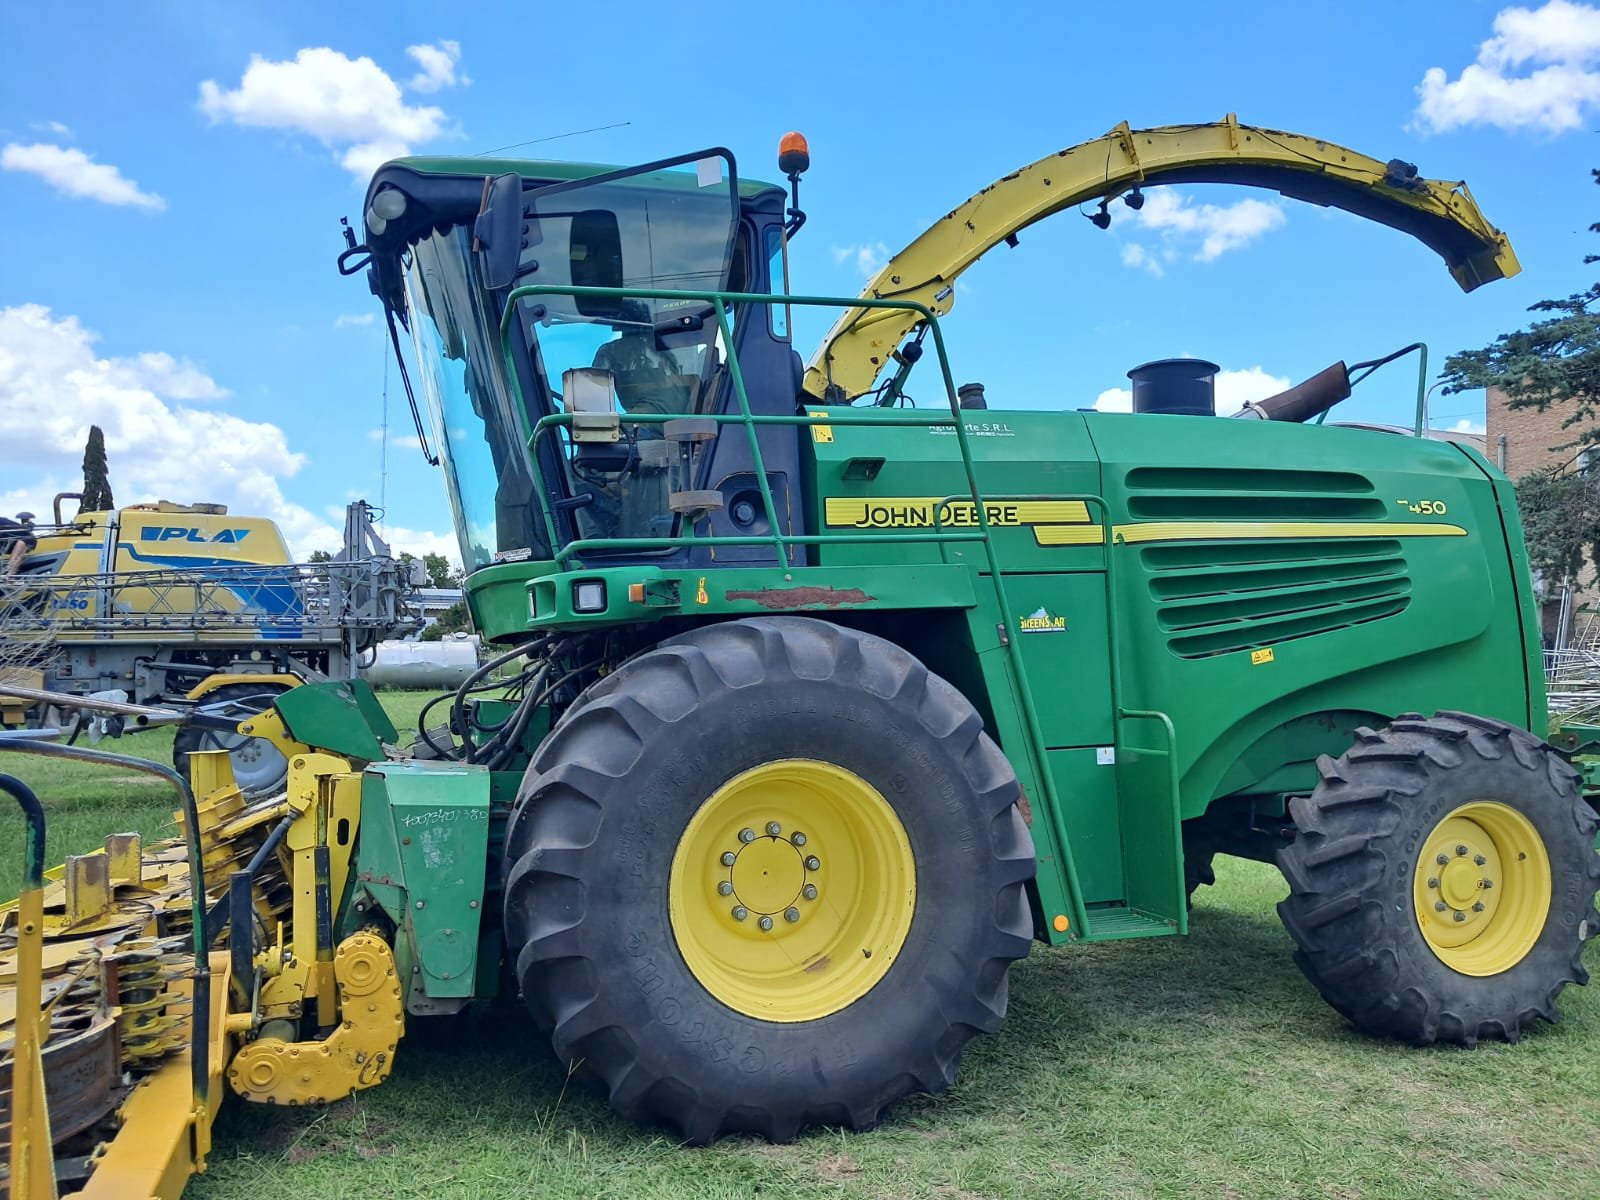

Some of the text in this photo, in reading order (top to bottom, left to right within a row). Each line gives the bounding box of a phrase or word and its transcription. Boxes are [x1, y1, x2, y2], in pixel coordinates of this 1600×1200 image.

[856, 503, 1018, 525] JOHN DEERE
[1396, 499, 1447, 515] 450
[158, 527, 236, 543] PLA
